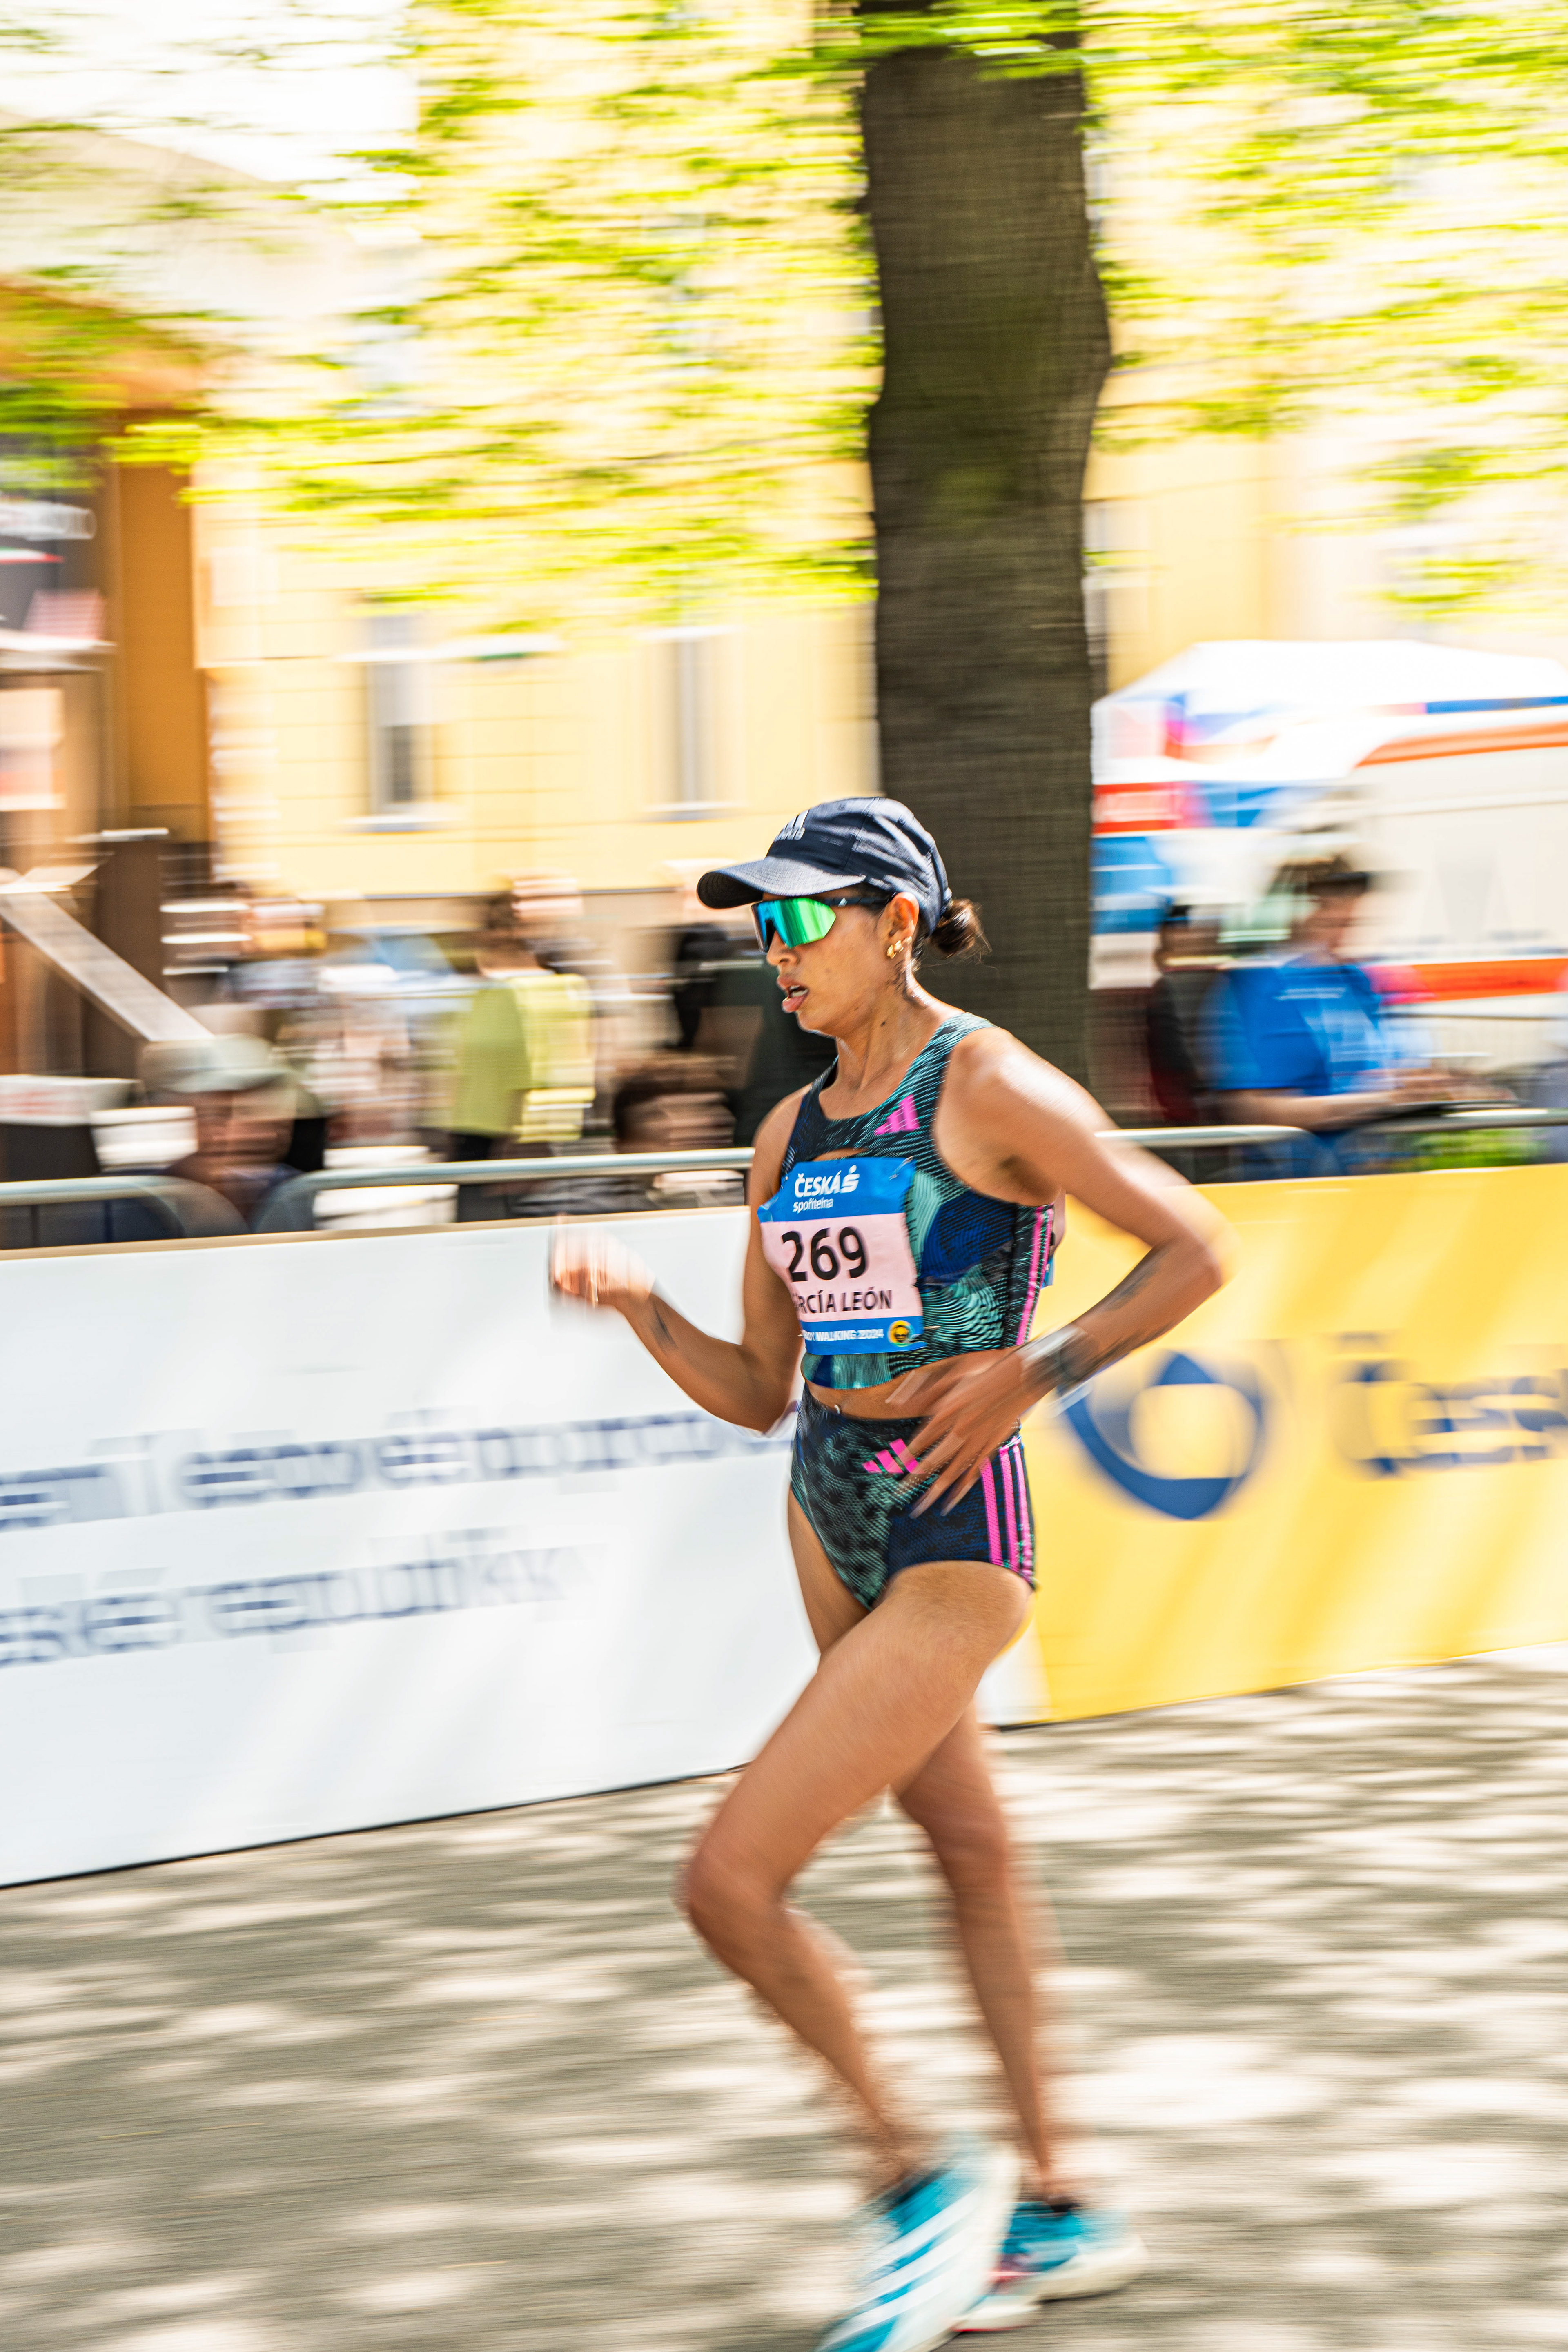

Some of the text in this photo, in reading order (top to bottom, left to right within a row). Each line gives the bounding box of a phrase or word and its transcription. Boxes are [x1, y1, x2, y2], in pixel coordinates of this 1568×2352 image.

[794, 1170, 842, 1198] ČESKÁ
[792, 1196, 834, 1214] spořitelna
[781, 1226, 869, 1282] 269
[795, 1286, 893, 1314] RCÍA LEÓN
[816, 1330, 857, 1342] WALKING
